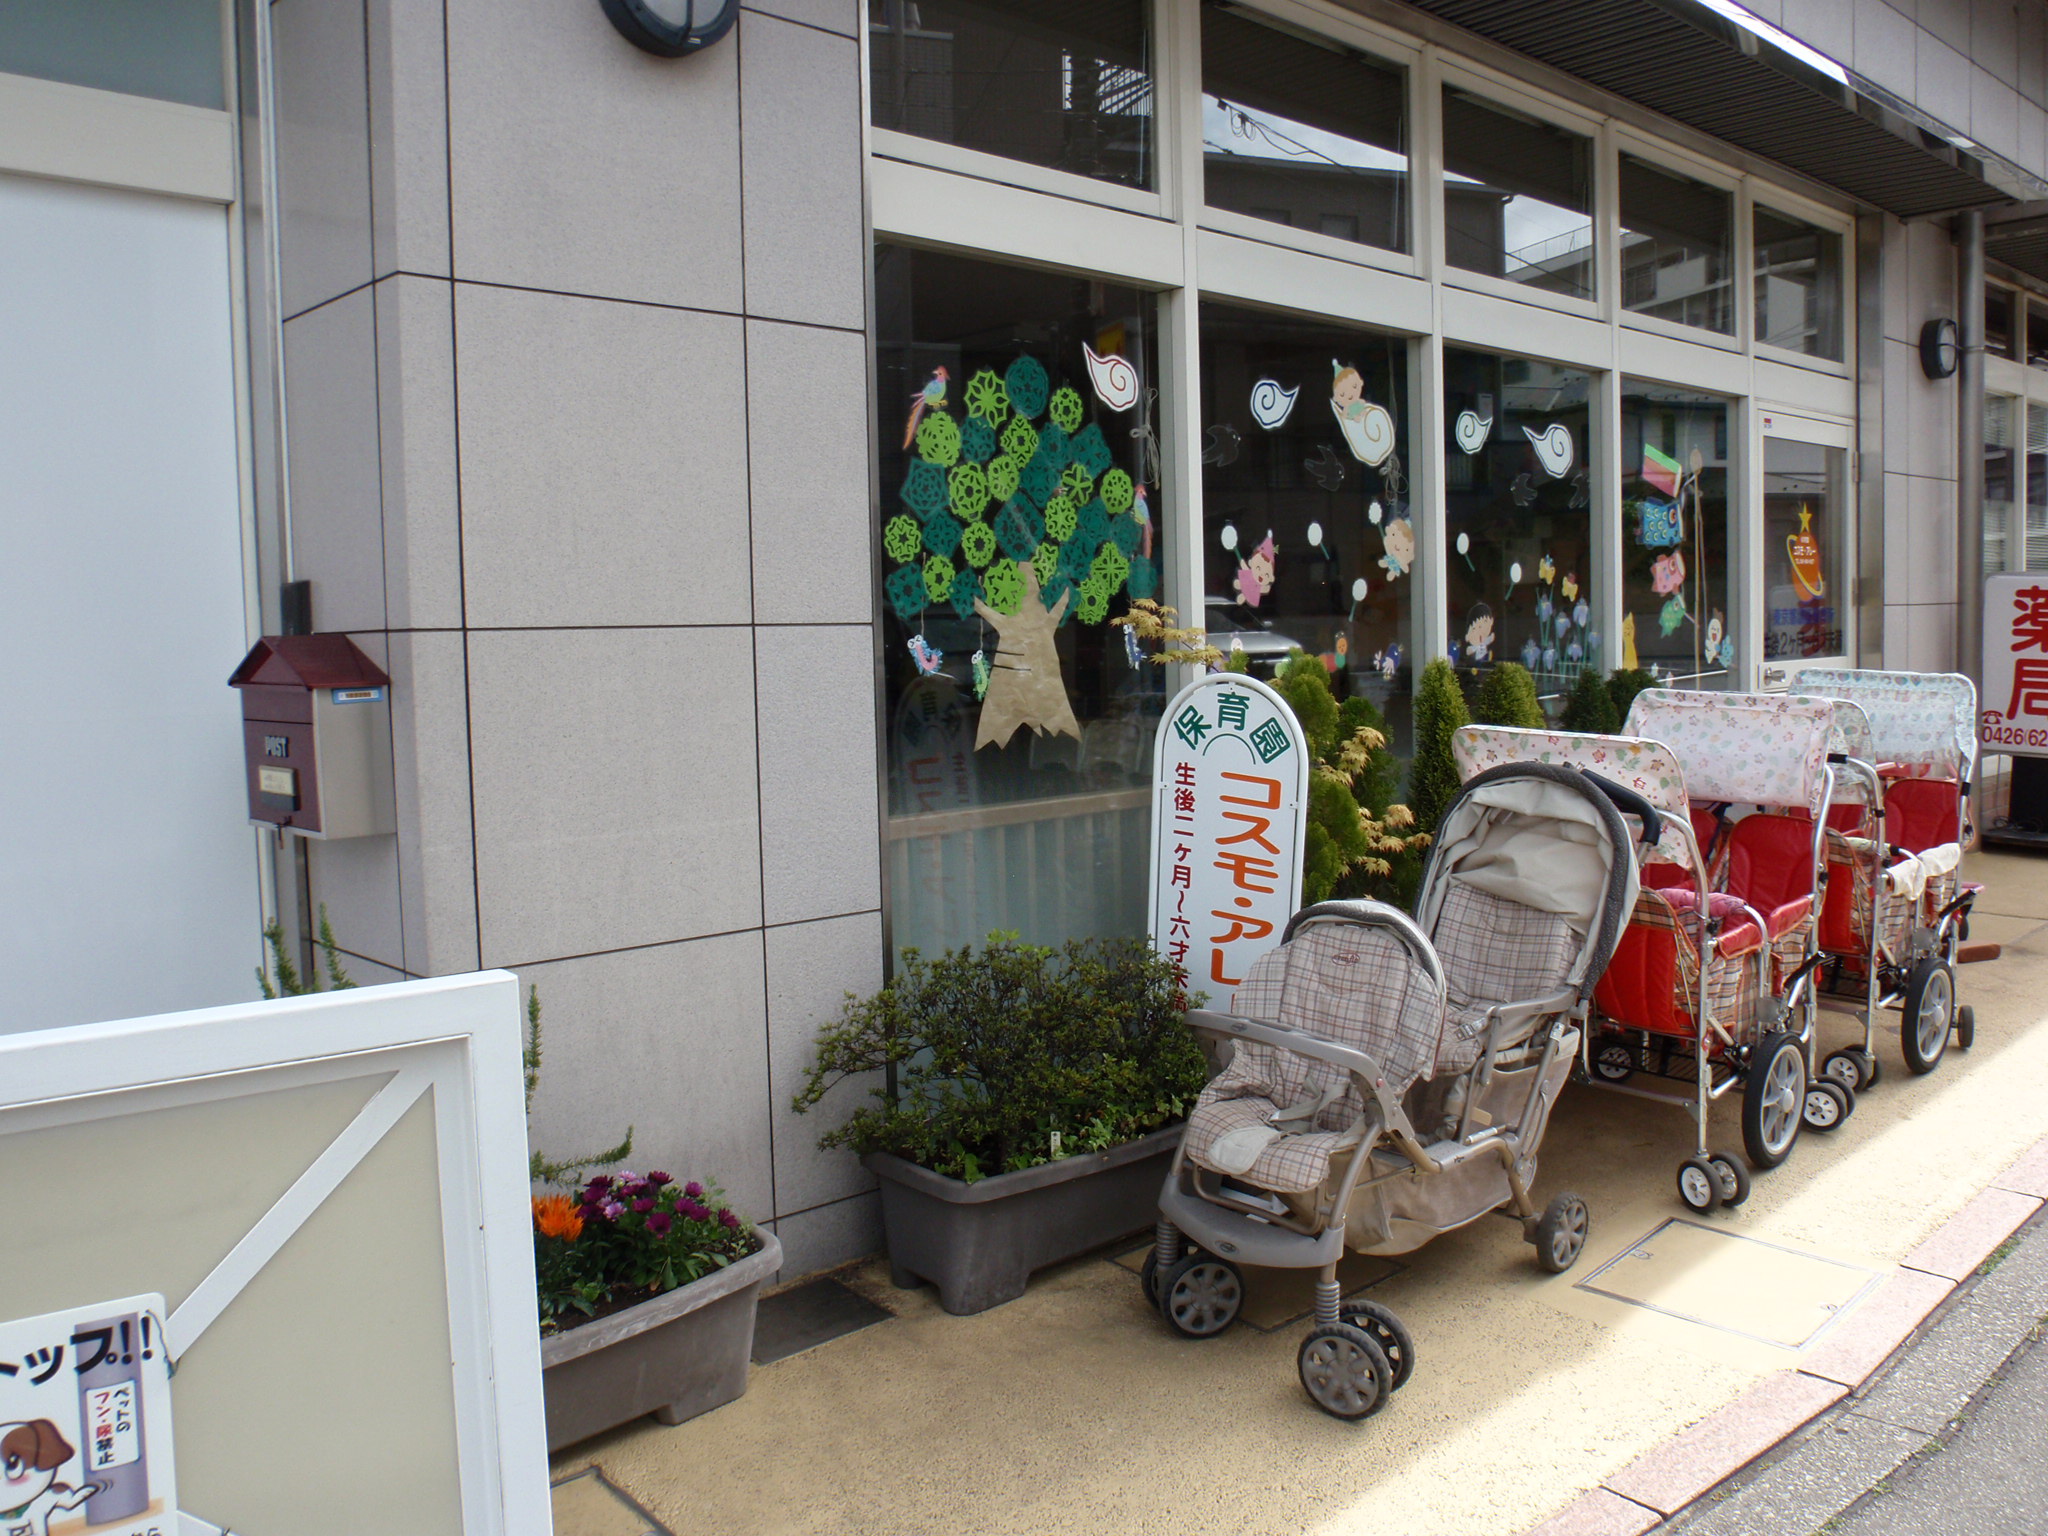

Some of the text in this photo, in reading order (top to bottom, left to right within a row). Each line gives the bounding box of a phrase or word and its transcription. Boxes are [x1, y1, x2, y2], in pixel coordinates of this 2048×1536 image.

[265, 736, 288, 757] POST
[1173, 692, 1291, 764] 保育園
